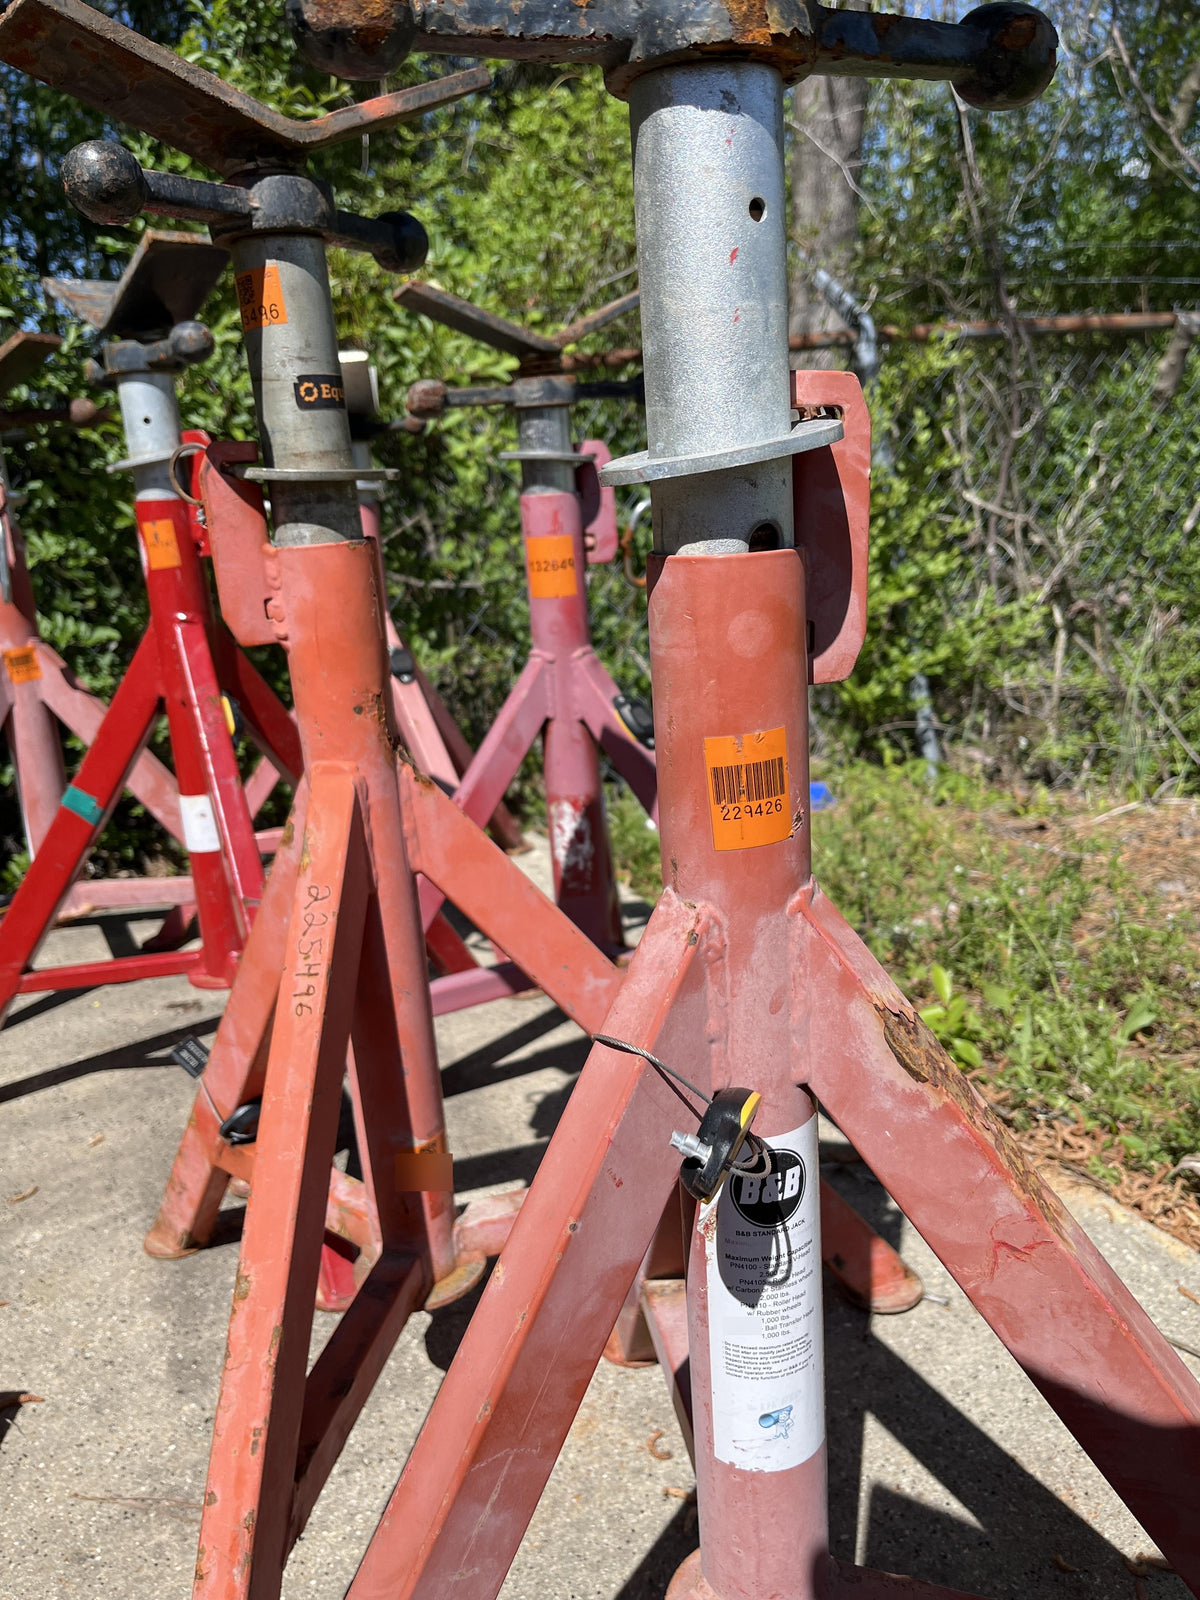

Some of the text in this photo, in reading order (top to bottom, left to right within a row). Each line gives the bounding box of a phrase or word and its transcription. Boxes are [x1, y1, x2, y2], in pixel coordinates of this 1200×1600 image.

[721, 798, 783, 821] 229426
[292, 885, 332, 1017] 225496
[739, 1164, 801, 1205] B&B
[735, 1218, 806, 1238] B&B STANDARD JACK
[725, 1252, 760, 1263] Maximum
[760, 1253, 786, 1263] Weight
[729, 1261, 757, 1270] PN4100
[763, 1259, 792, 1270] Standard
[792, 1248, 811, 1261] V-Head
[739, 1278, 767, 1286] PN4105
[791, 1266, 806, 1278] Head
[735, 1286, 760, 1294] Carbon
[770, 1280, 798, 1292] Stainless
[740, 1301, 767, 1310] PN4110
[773, 1298, 792, 1307] Roller
[792, 1289, 807, 1302] Head
[760, 1293, 778, 1301] 2,000
[756, 1309, 781, 1317] Rubber
[782, 1302, 802, 1313] wheels
[761, 1316, 779, 1324] 1,000
[765, 1324, 778, 1332] Ball
[779, 1316, 802, 1329] Transfer
[761, 1332, 780, 1340] 1,000
